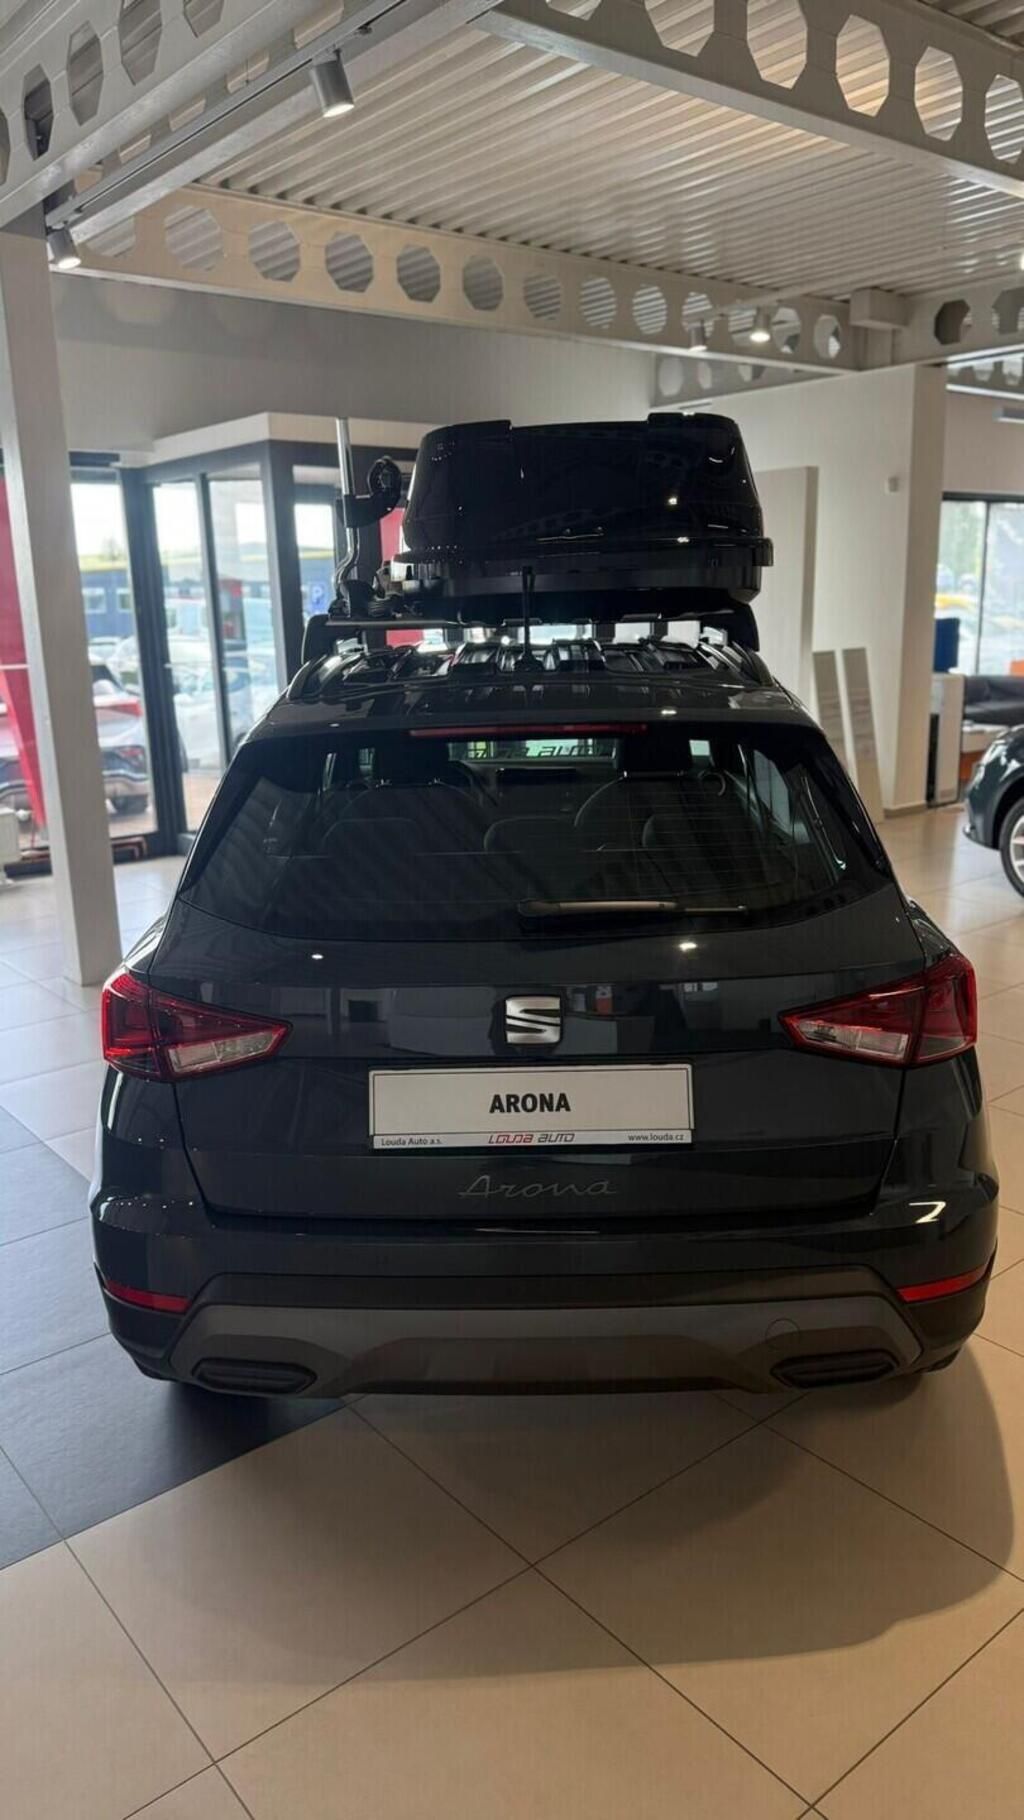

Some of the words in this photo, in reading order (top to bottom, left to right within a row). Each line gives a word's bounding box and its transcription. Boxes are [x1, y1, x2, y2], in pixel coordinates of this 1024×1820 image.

[489, 1093, 571, 1113] ARONA
[381, 1137, 406, 1146] Louda
[408, 1137, 428, 1145] Auto
[628, 1132, 684, 1141] www.louda.cz
[458, 1174, 617, 1198] Arona
